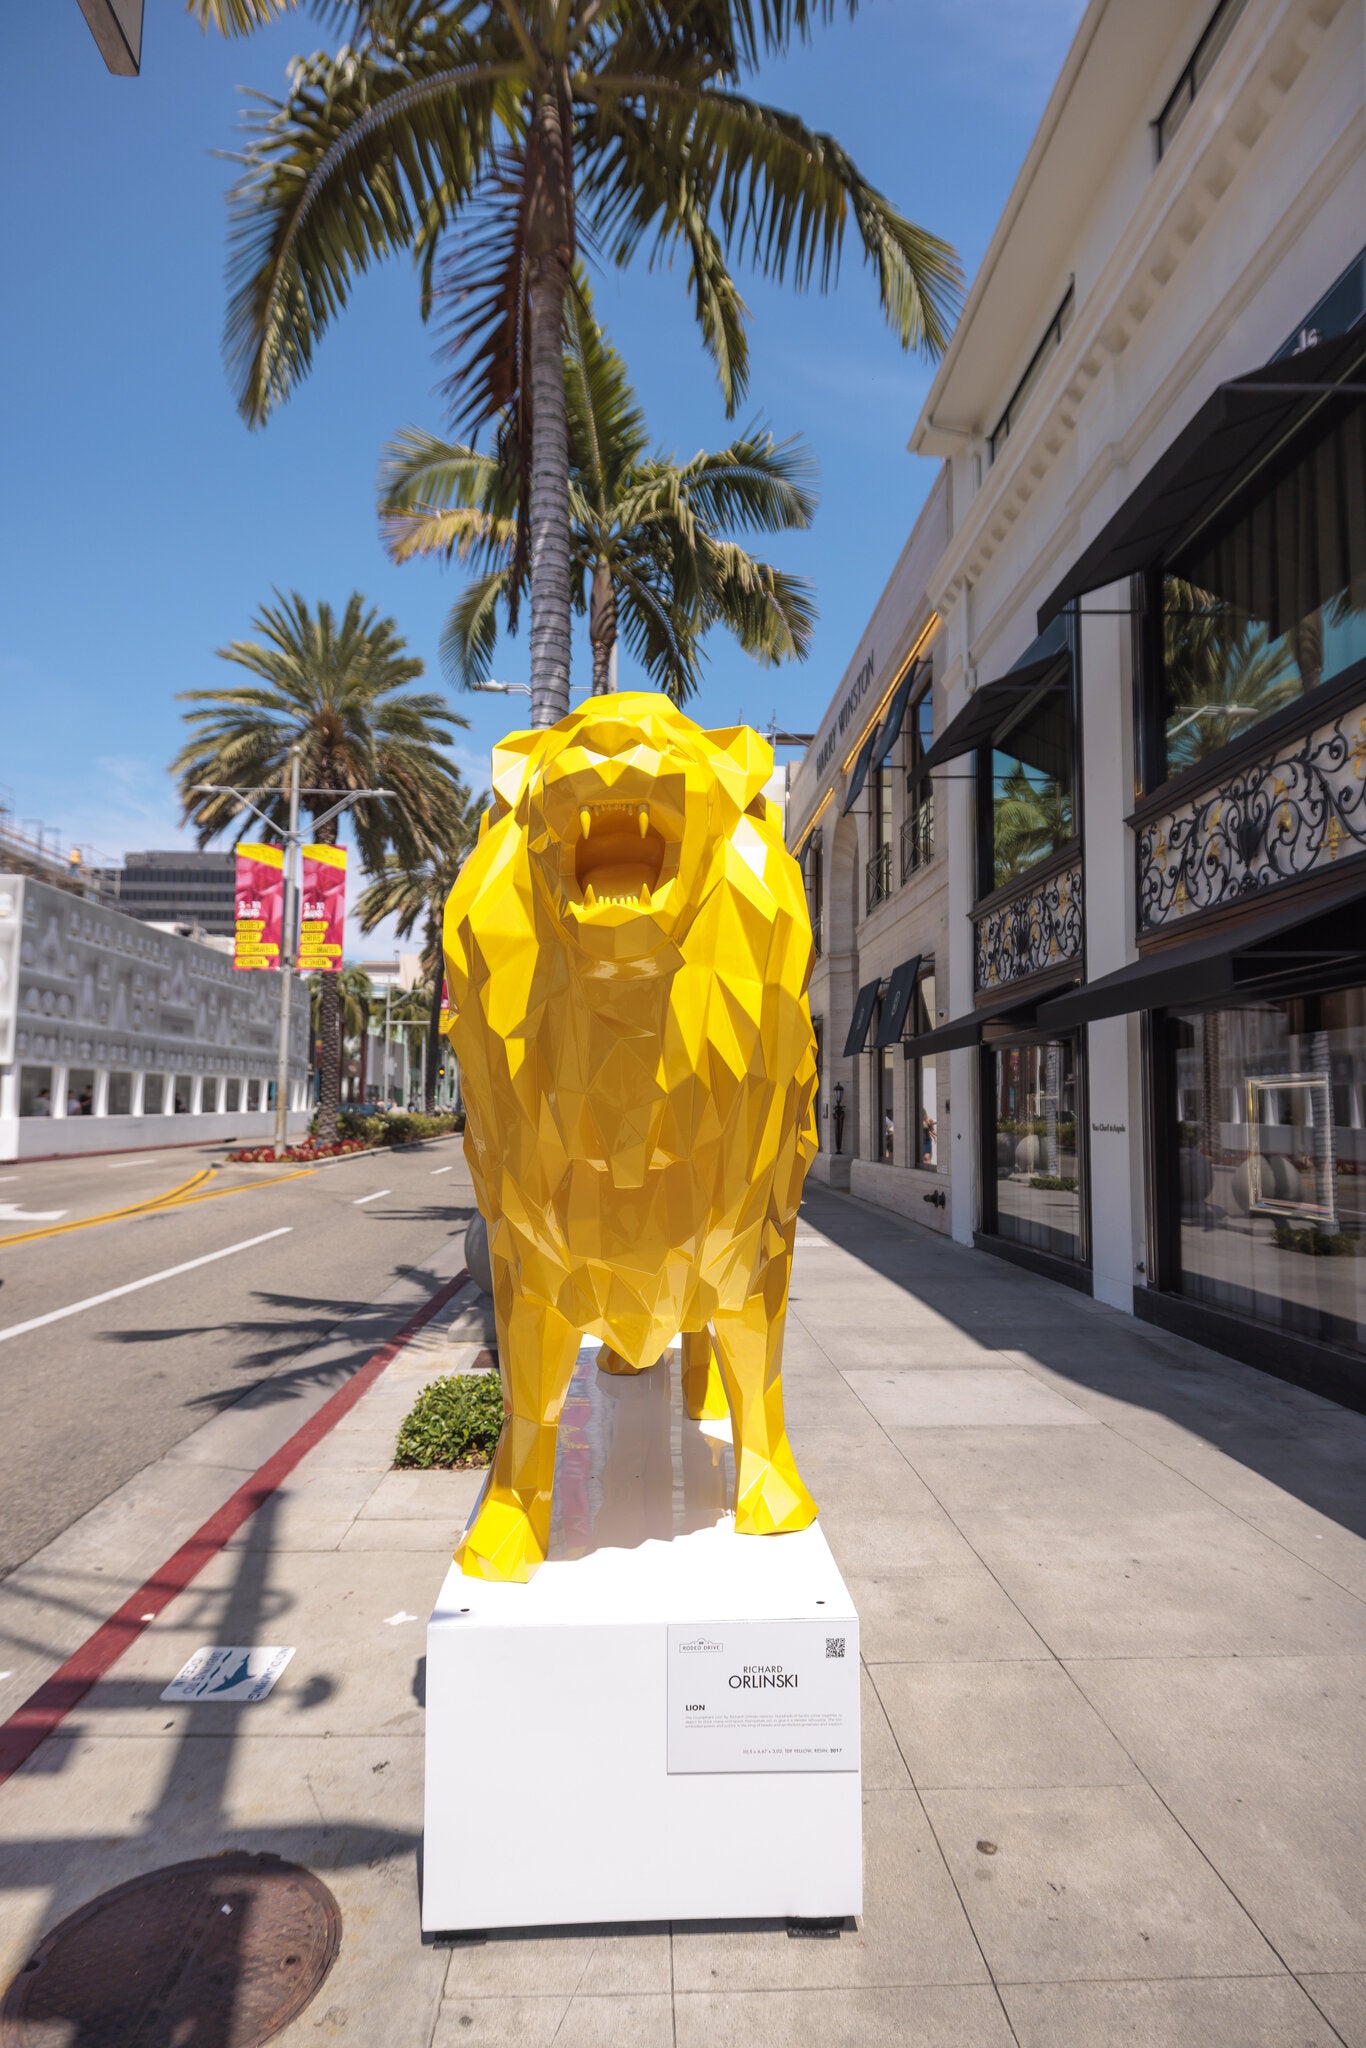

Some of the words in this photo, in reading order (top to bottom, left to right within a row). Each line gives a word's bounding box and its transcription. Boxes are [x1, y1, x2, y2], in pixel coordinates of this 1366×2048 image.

[816, 721, 837, 781] HARRY
[838, 648, 875, 737] WINSTON
[743, 1665, 783, 1674] RICHARD
[728, 1674, 798, 1689] ORLINSKI
[685, 1704, 706, 1712] LION
